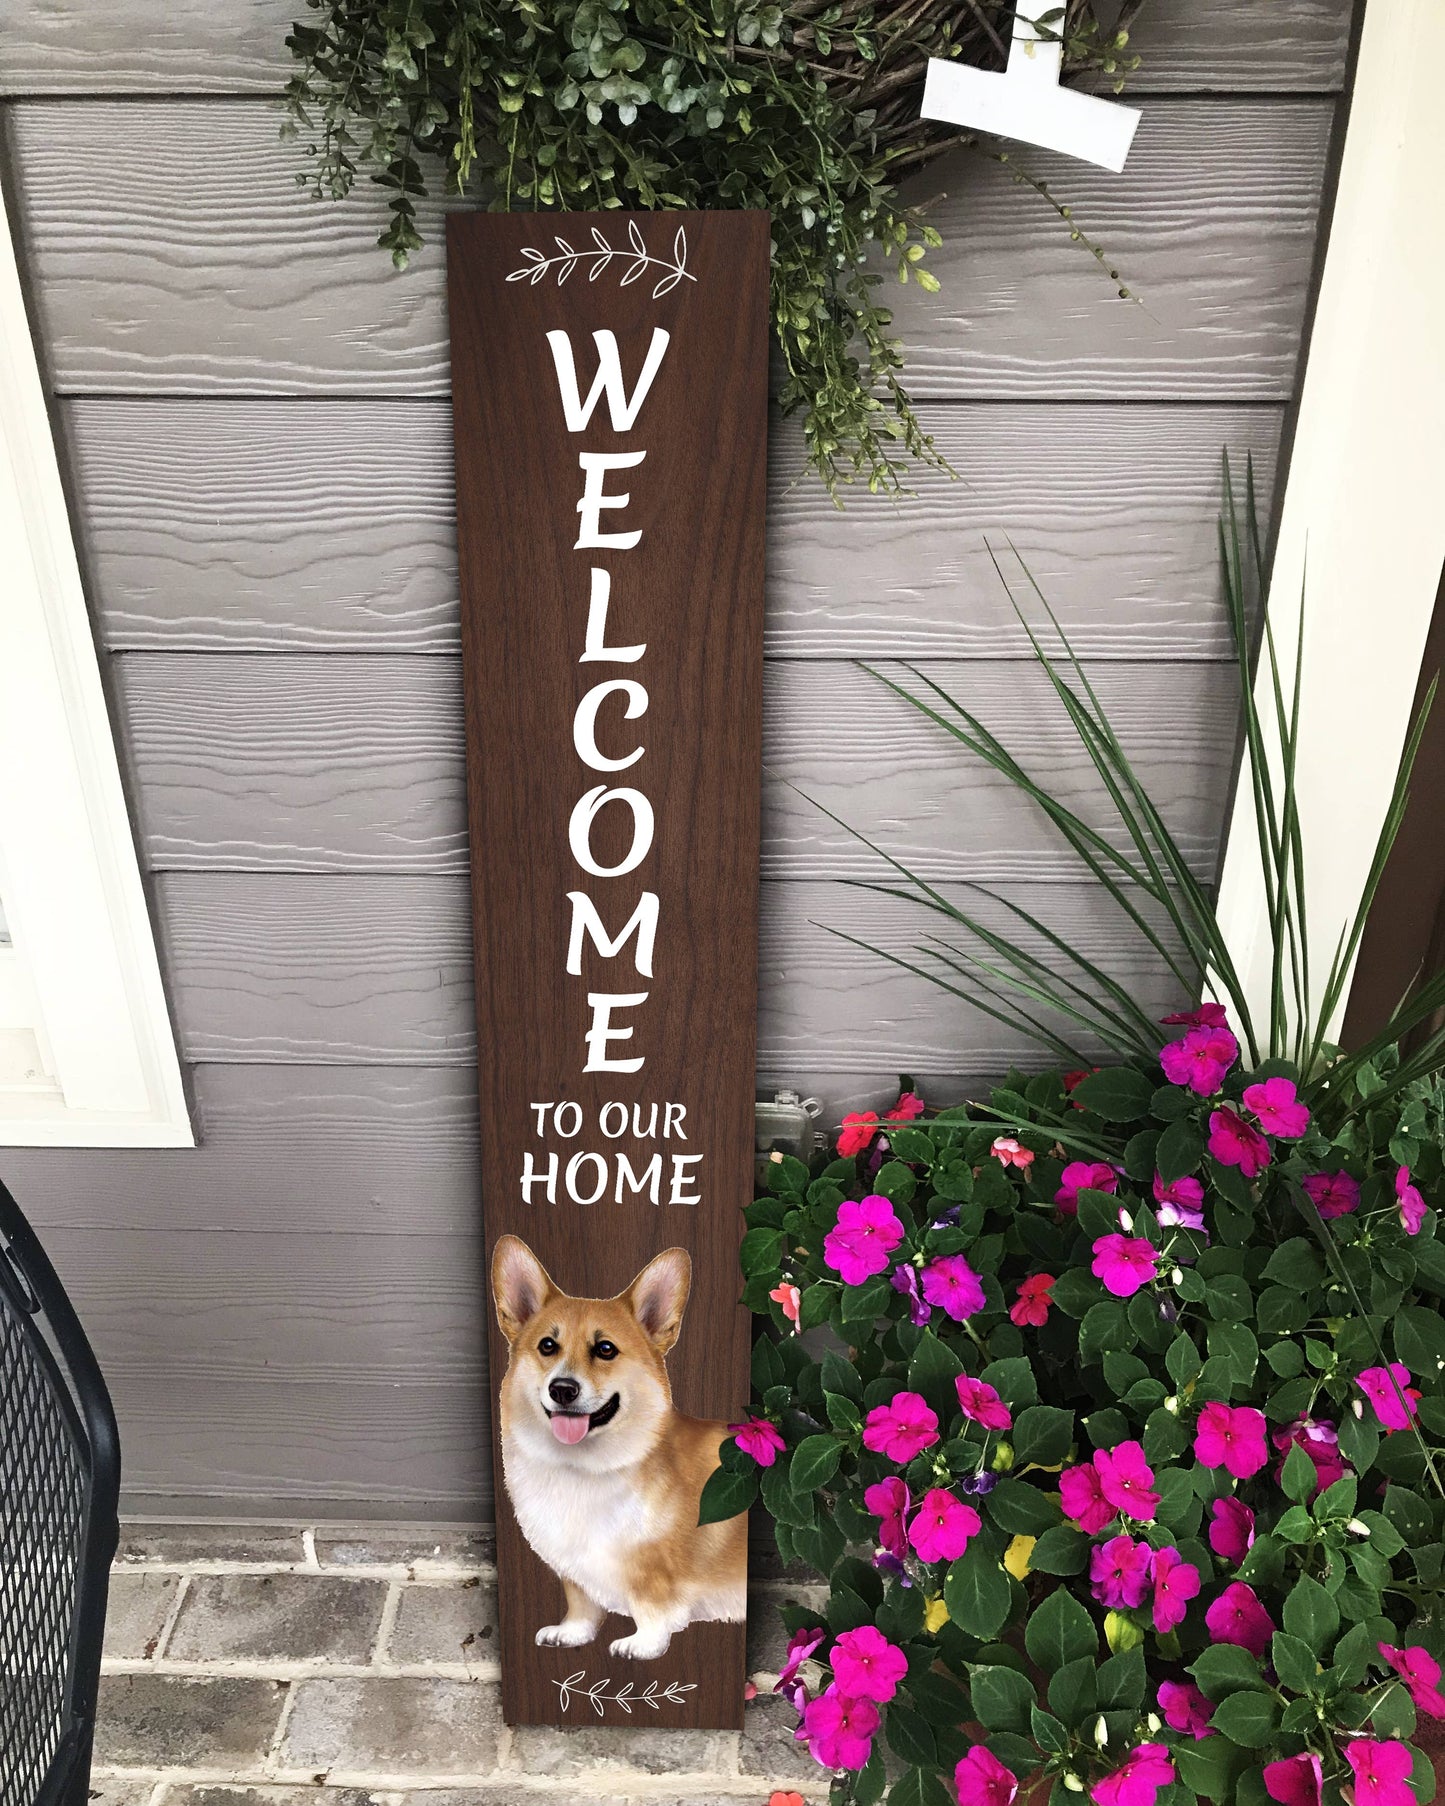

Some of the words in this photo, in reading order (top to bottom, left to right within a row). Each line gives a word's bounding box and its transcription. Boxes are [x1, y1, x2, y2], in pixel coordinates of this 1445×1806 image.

[545, 327, 671, 1074] WELCOME
[529, 1101, 583, 1139] TO
[599, 1101, 688, 1140] OUR
[520, 1151, 703, 1206] HOME
